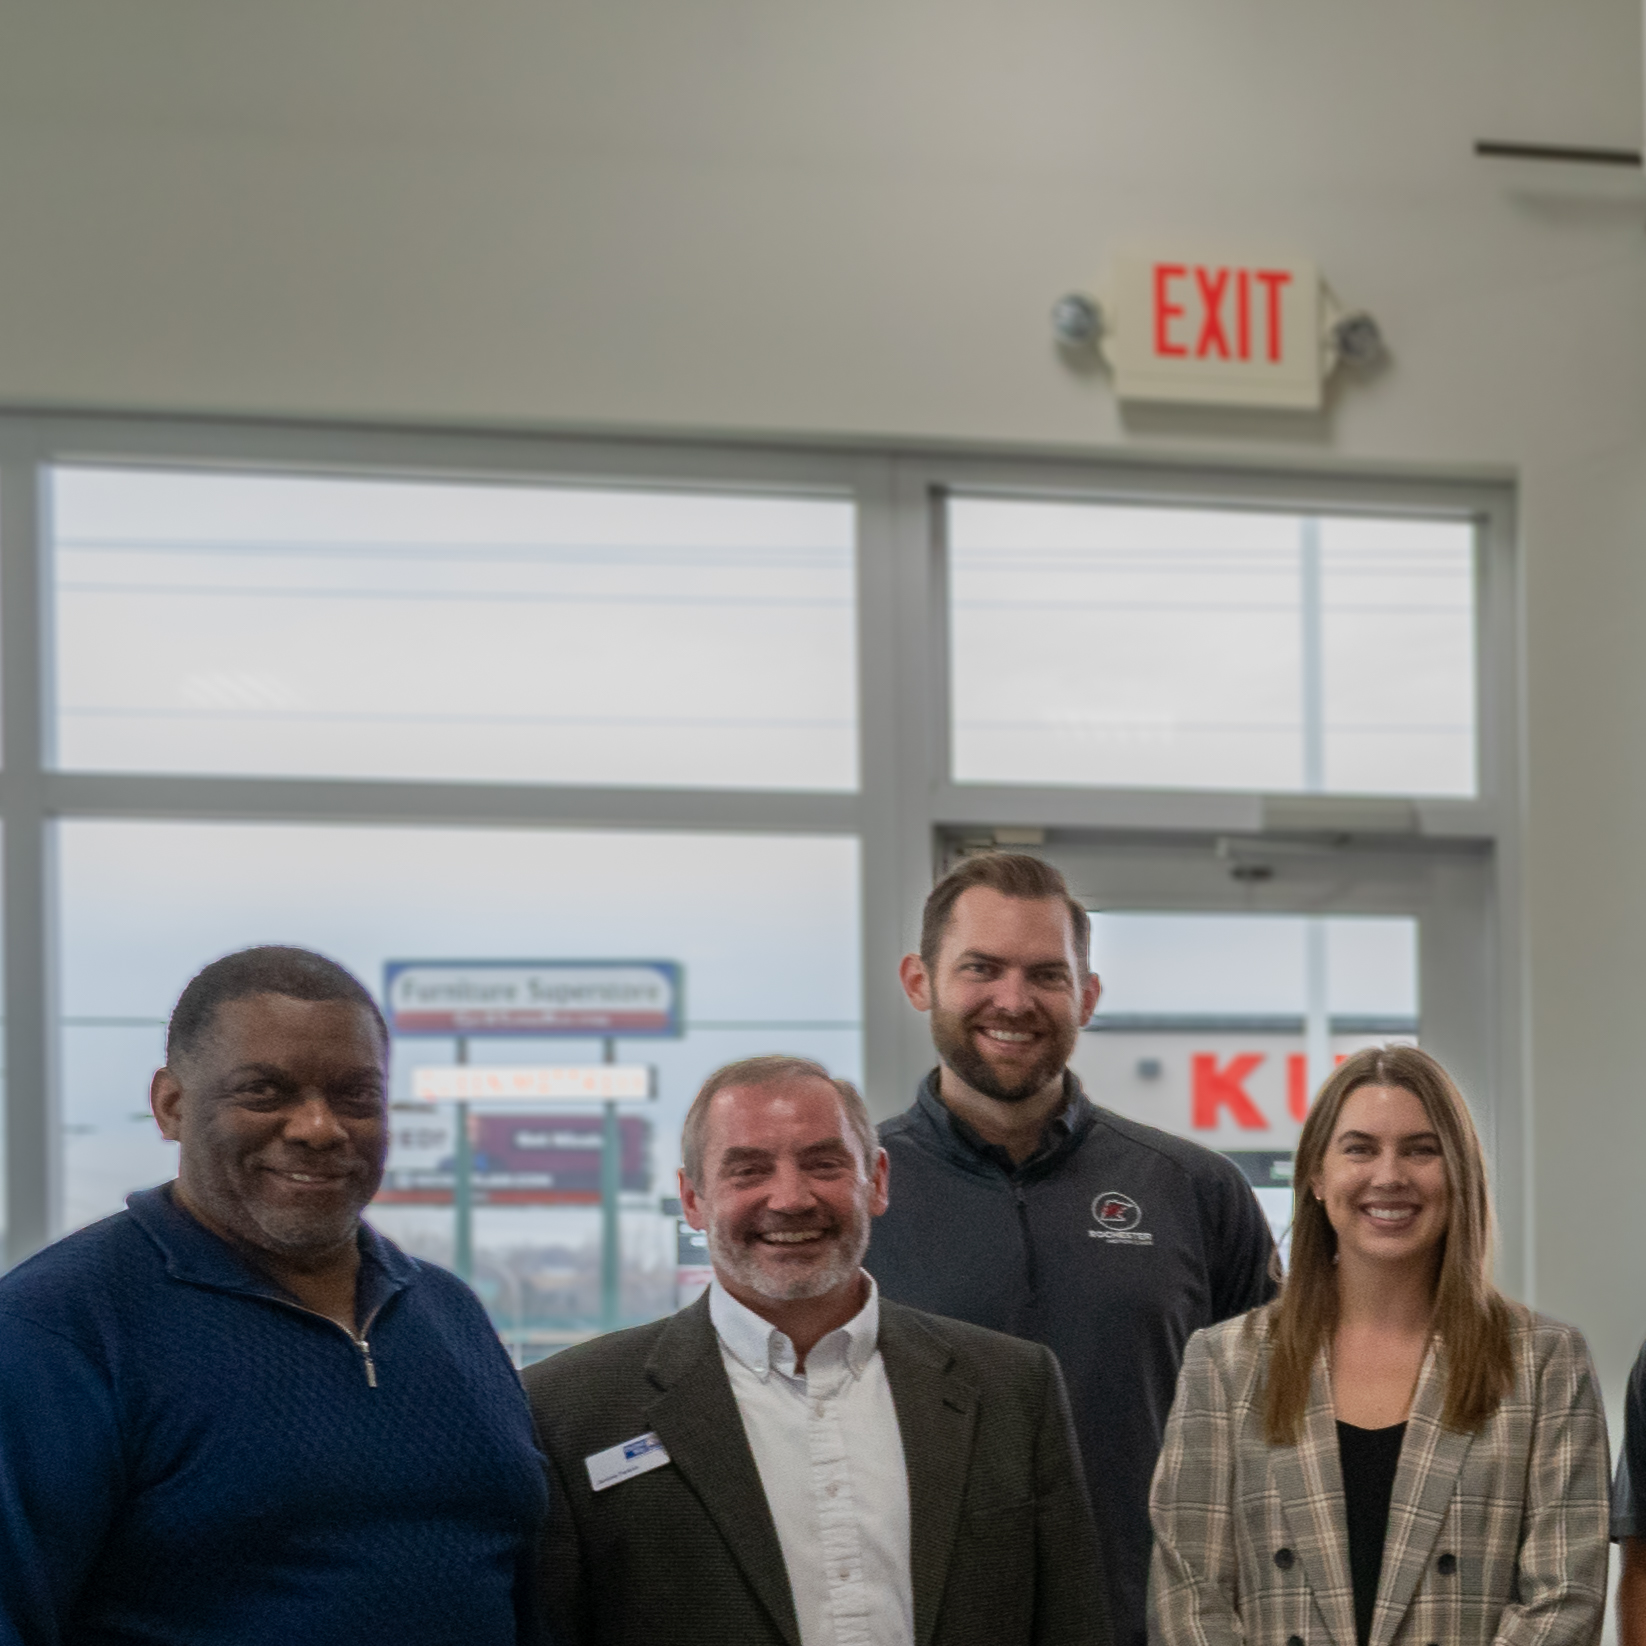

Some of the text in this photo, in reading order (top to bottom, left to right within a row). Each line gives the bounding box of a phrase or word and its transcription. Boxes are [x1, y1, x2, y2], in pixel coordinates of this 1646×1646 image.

[1153, 263, 1292, 363] EXIT
[401, 976, 660, 1006] Furniture Superstore
